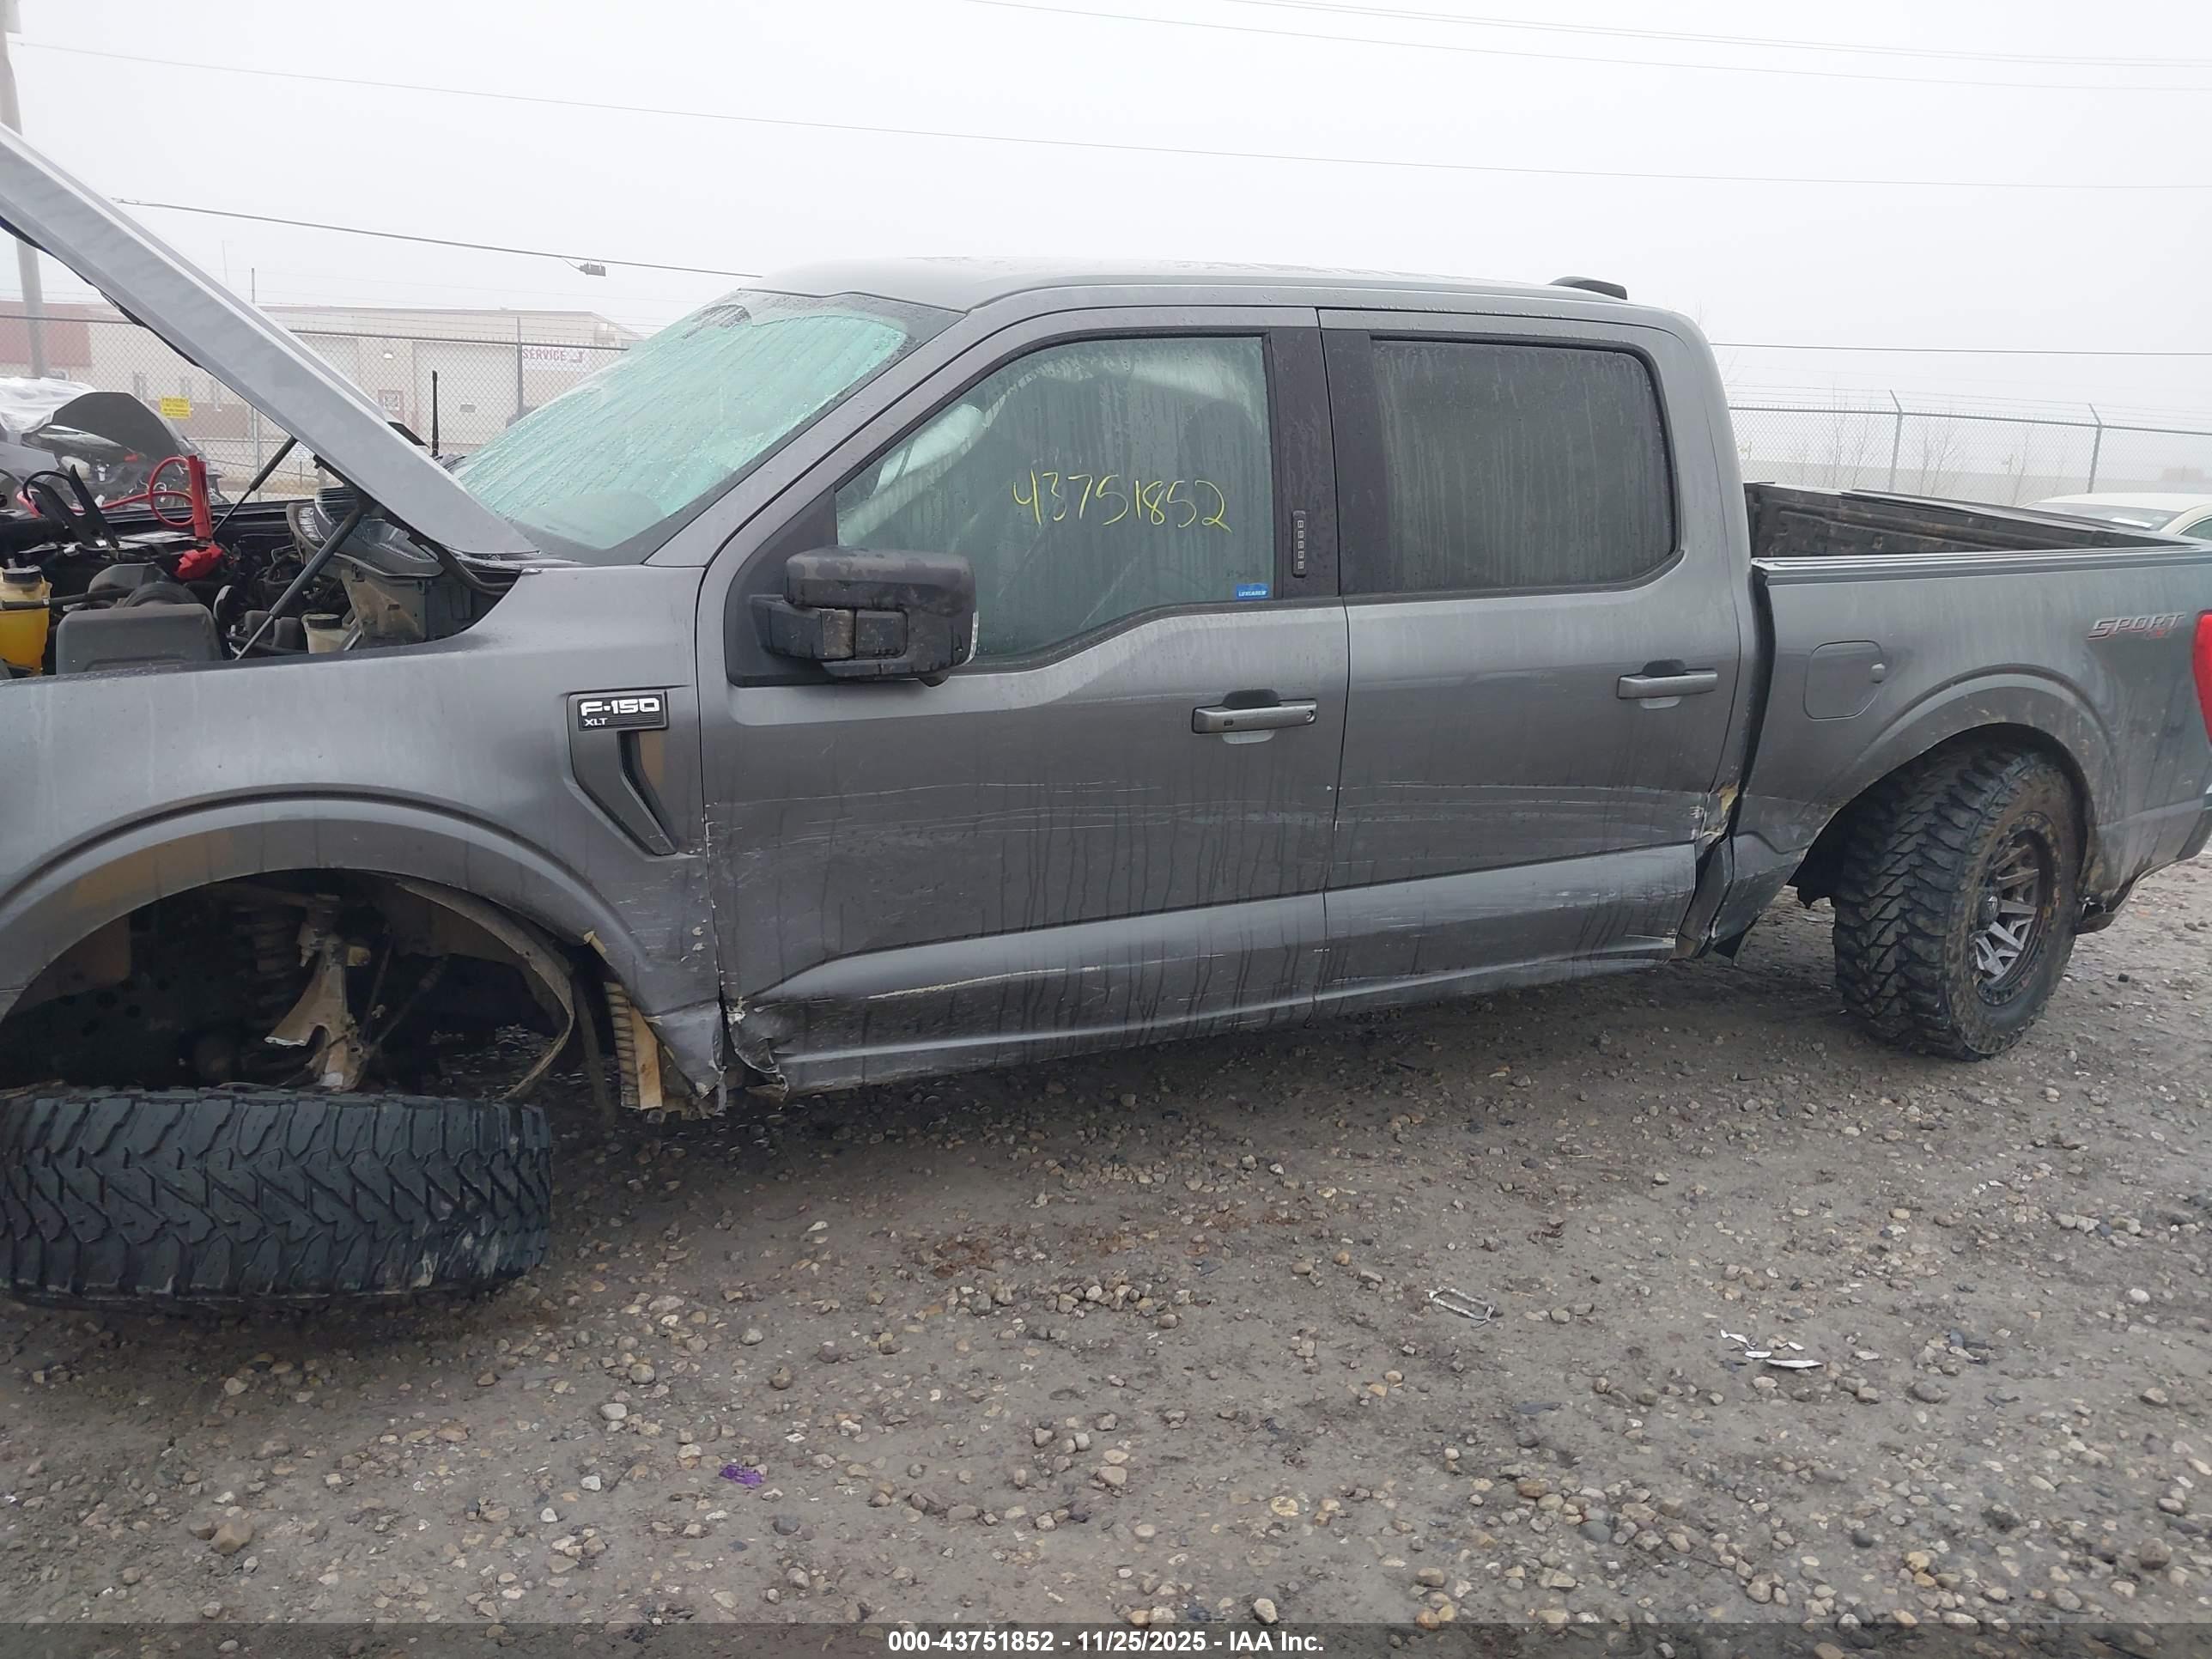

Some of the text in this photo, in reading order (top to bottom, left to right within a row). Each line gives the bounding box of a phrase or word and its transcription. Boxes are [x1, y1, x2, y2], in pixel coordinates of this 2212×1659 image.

[523, 348, 566, 362] SERVICE
[1013, 468, 1233, 534] 43751852
[2087, 611, 2185, 640] SPORT
[580, 697, 660, 717] F-150
[584, 717, 608, 727] XLT
